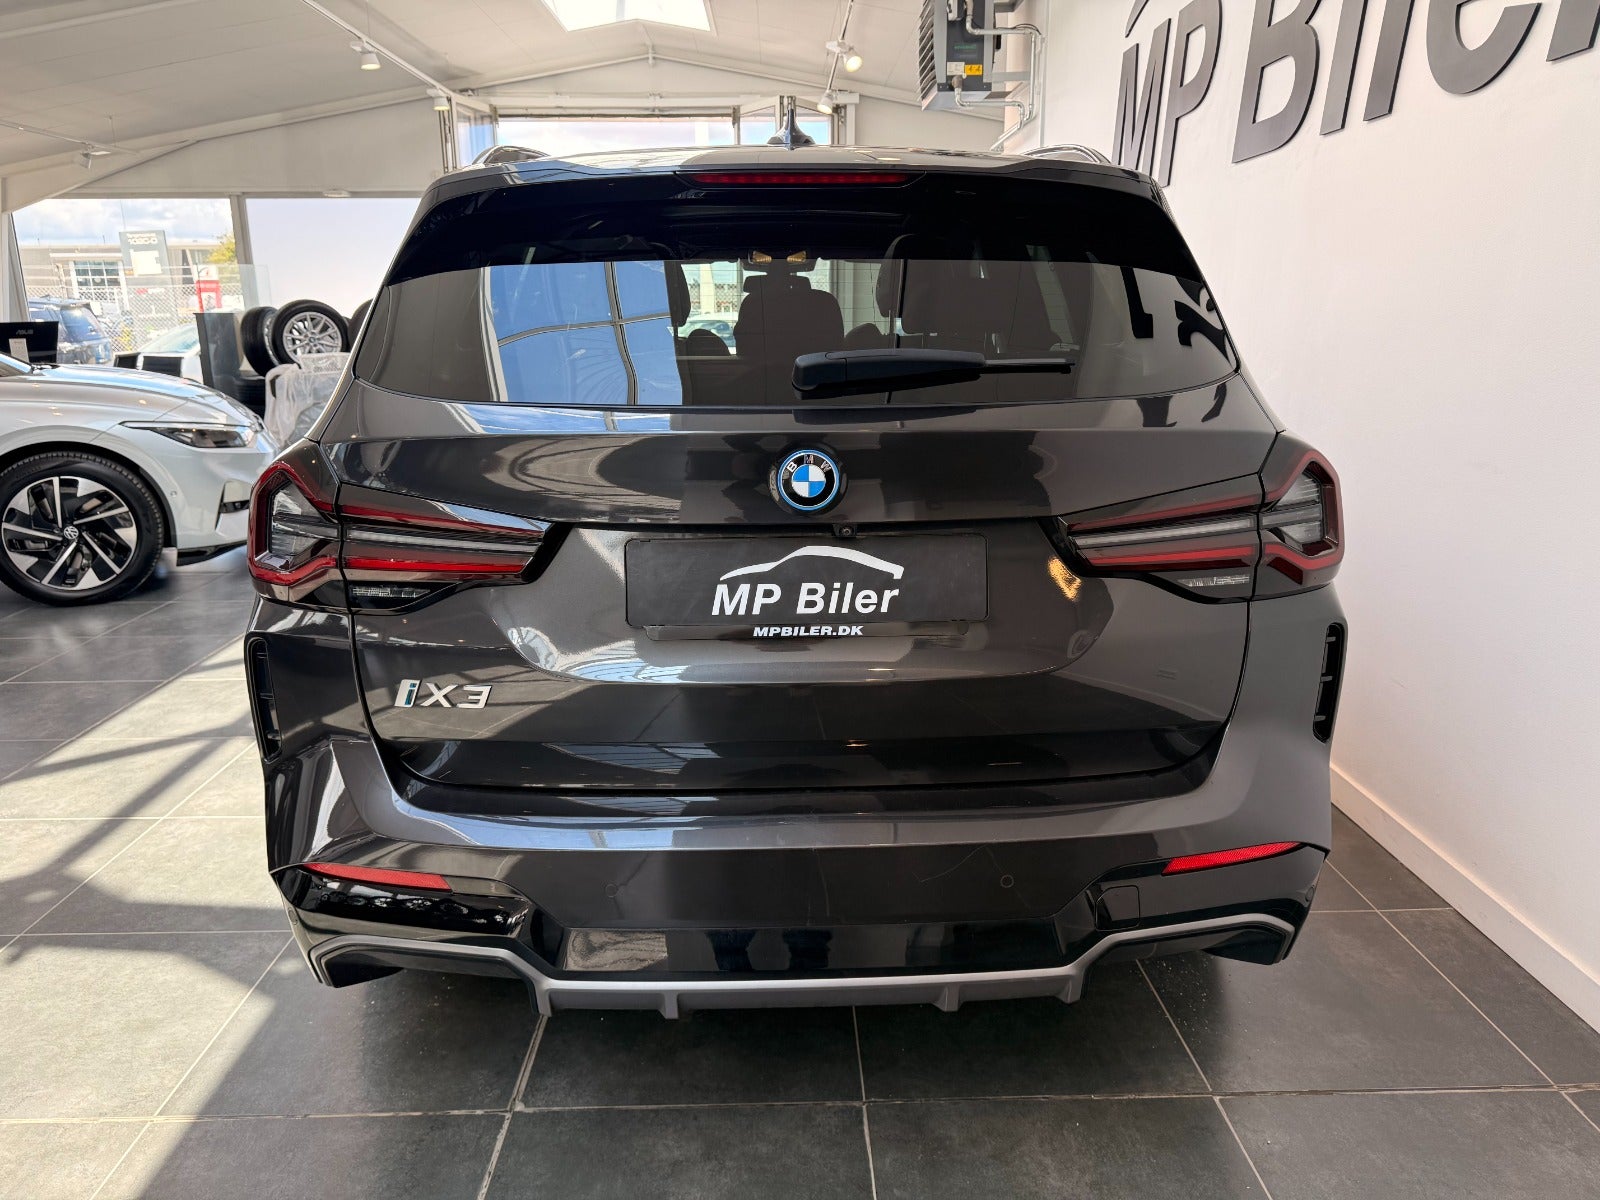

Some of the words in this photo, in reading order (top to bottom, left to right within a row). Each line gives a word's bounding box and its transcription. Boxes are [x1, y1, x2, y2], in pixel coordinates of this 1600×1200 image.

[1112, 0, 1223, 188] MP
[1232, 0, 1600, 164] Bile
[786, 454, 832, 473] BMW
[711, 583, 782, 616] MP
[796, 582, 900, 615] Biler
[752, 625, 864, 637] MPBILER.DK
[394, 679, 492, 709] iX3
